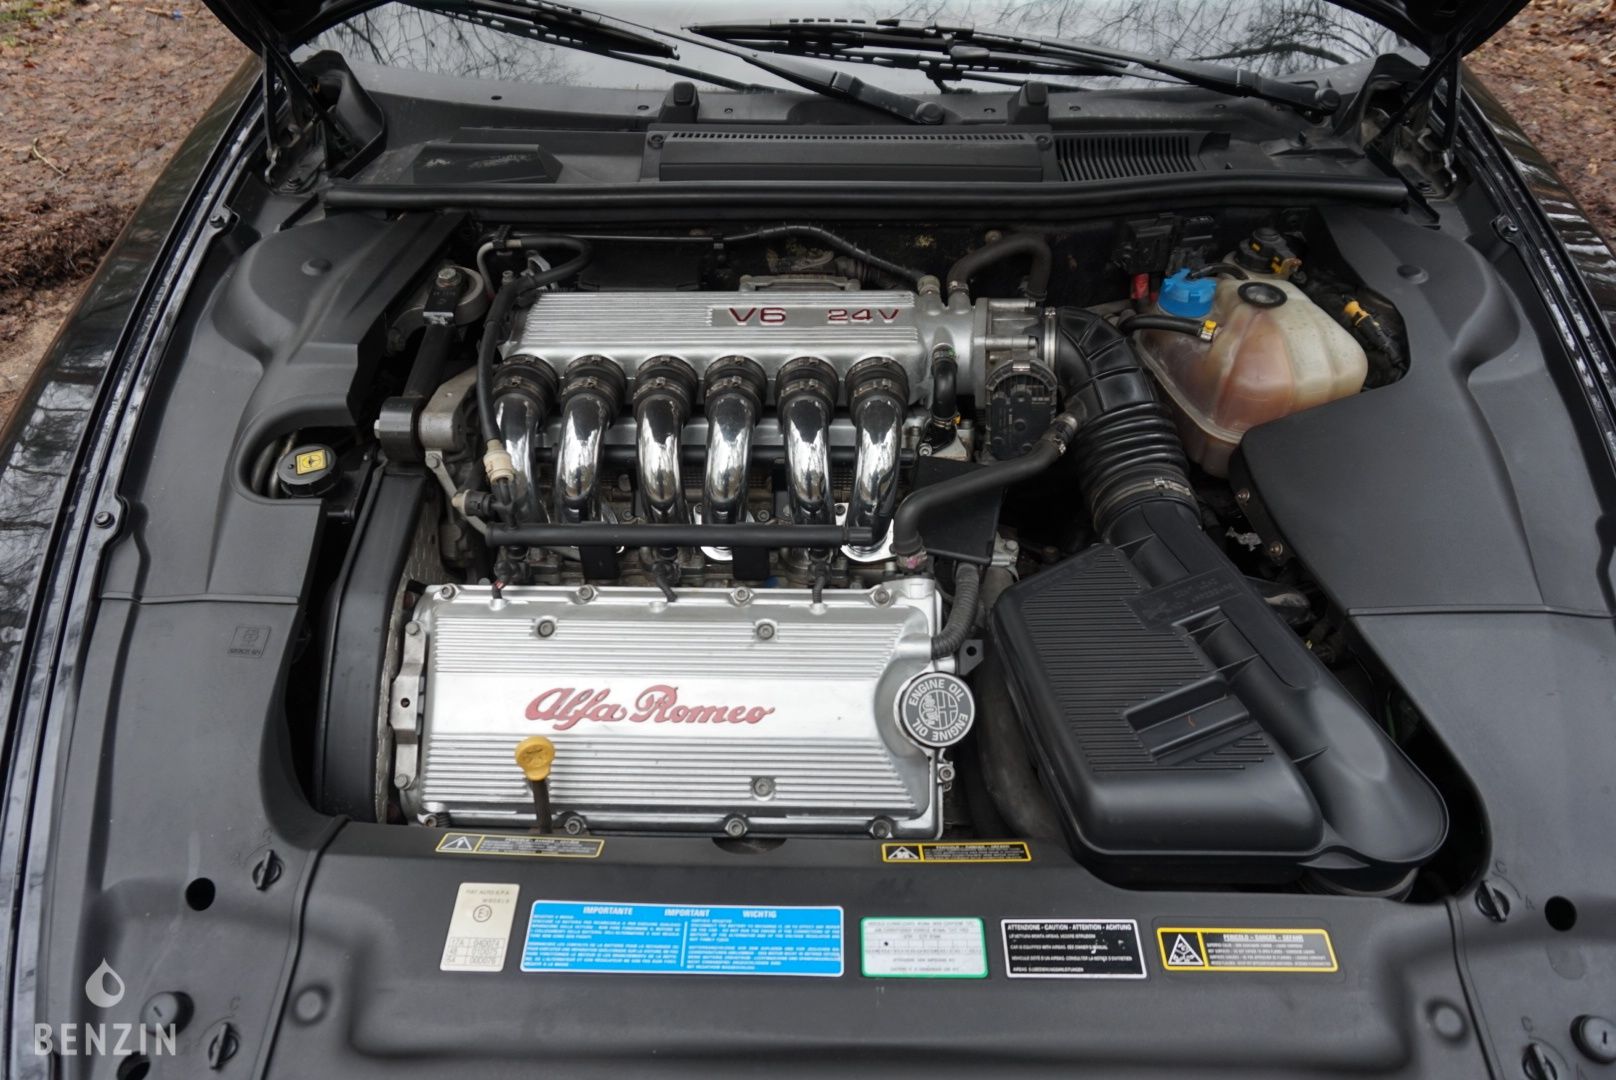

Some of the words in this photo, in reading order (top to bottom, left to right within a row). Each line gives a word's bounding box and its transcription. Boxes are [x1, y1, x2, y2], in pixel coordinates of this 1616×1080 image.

[728, 307, 787, 326] V6
[827, 308, 900, 324] 24V
[909, 678, 945, 706] ENGINE
[948, 682, 965, 703] OIL
[524, 687, 628, 731] Alfa
[629, 684, 775, 724] Romeo
[912, 717, 929, 738] OIL
[931, 712, 969, 742] ENGINE
[583, 906, 634, 915] IMPORTANTE
[664, 908, 710, 917] IMPORTANT
[742, 910, 777, 919] WICHTIG
